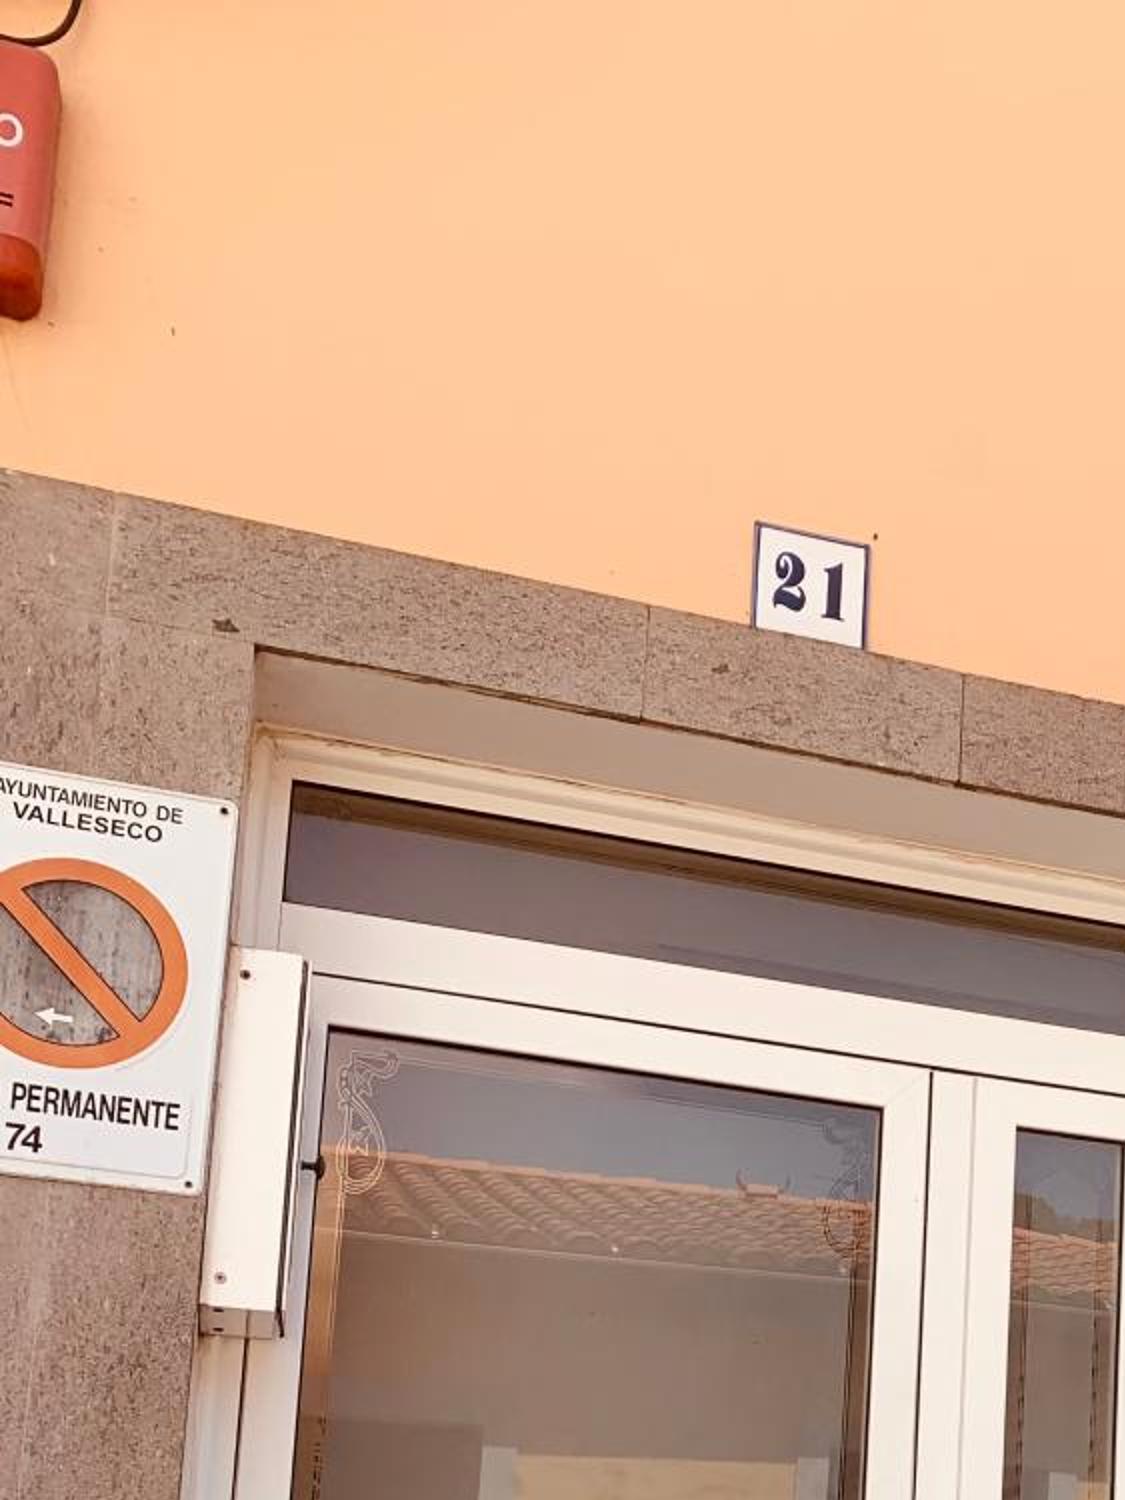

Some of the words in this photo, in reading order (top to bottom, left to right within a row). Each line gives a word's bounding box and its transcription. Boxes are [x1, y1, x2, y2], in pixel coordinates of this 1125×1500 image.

[772, 551, 844, 622] 21
[0, 777, 147, 818] AYUNTAMIENTO
[156, 805, 183, 825] DE
[13, 801, 163, 842] VALLESECO
[10, 1082, 181, 1131] PERMANENTE
[5, 1121, 43, 1153] 74
